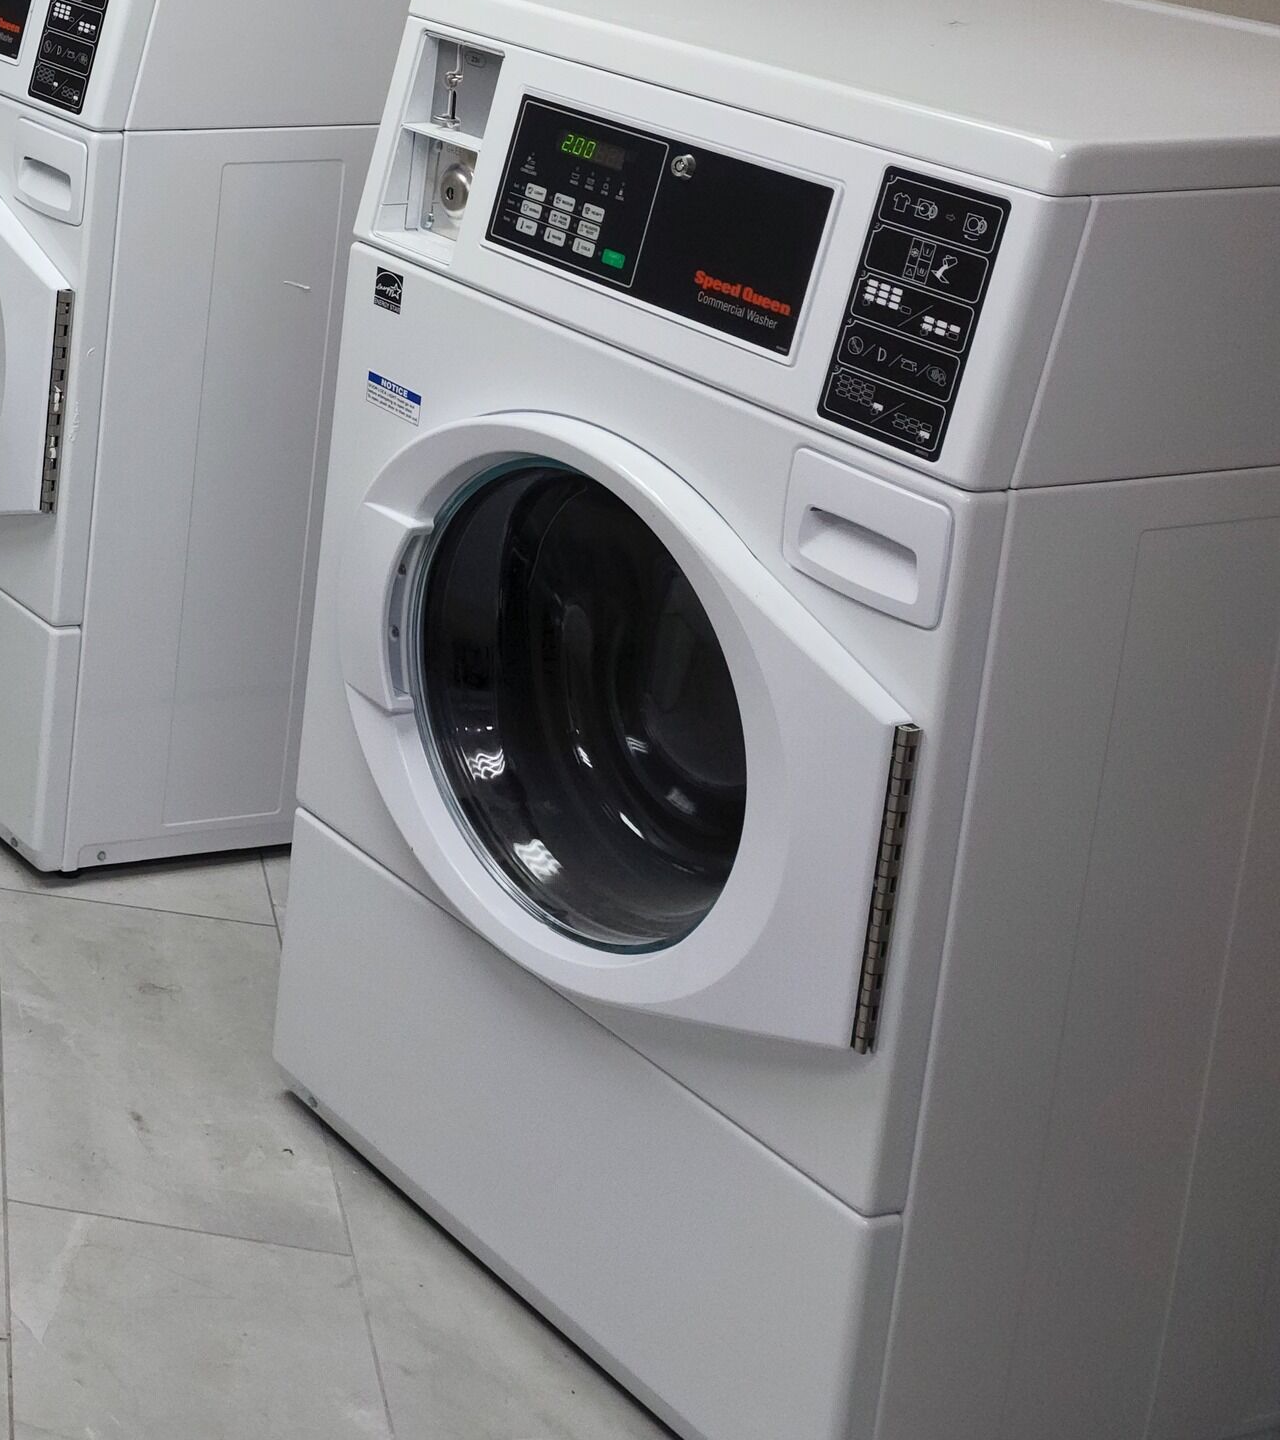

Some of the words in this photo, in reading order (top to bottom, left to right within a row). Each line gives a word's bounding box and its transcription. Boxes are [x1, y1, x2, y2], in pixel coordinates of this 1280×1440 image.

[561, 134, 596, 159] 2.00
[694, 270, 742, 297] Speed
[742, 287, 791, 316] Queen
[697, 290, 745, 318] Commercial
[746, 308, 778, 329] Washer
[381, 378, 408, 398] NOTICE
